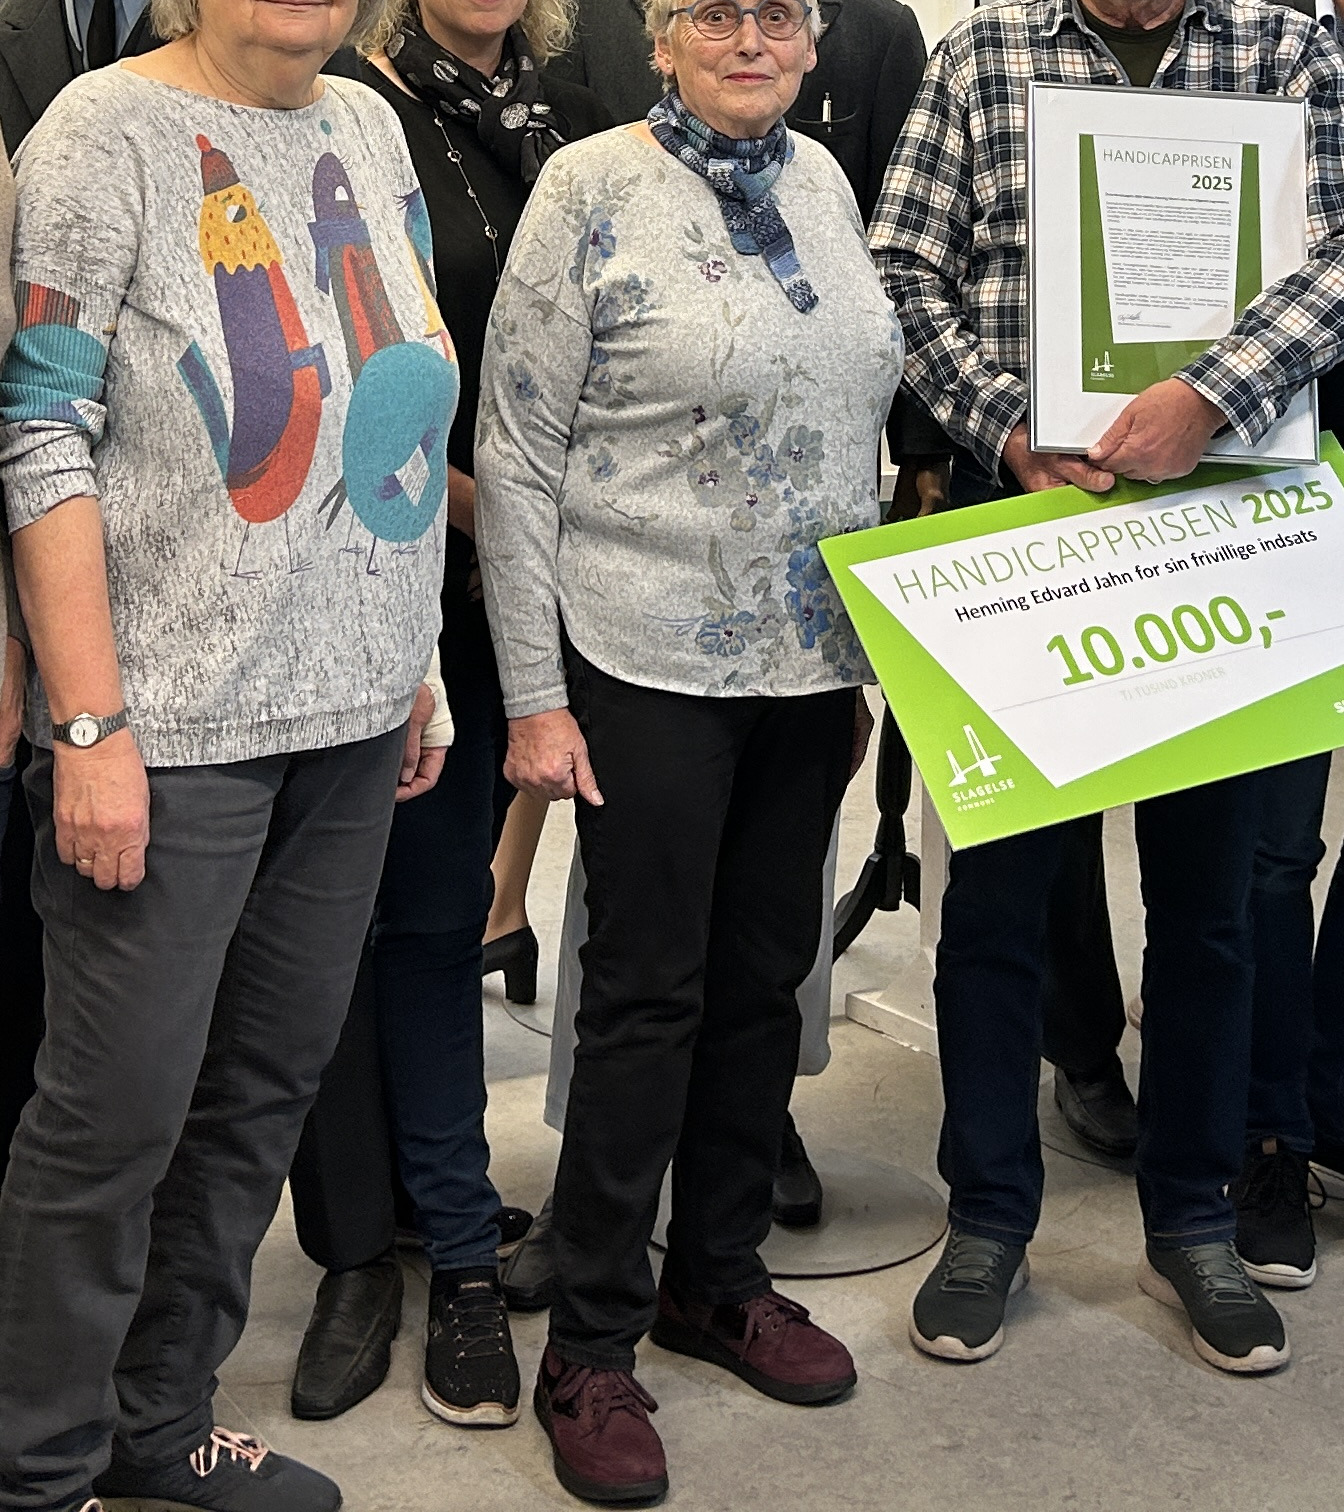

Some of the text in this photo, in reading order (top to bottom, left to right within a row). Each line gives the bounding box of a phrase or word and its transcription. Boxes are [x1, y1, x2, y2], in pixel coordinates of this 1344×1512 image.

[1102, 148, 1233, 170] HANDICAPPRISEN
[1191, 174, 1233, 191] 2025
[893, 480, 1334, 604] HANDICAPPRISEN 2025
[954, 528, 1318, 623] Henning Edvard Jahn for sin frivillige indsats
[1046, 595, 1286, 686] 10.000,-
[1134, 678, 1178, 697] TUSIND
[1178, 666, 1226, 687] KRONER
[952, 778, 1016, 803] SLAGELSE
